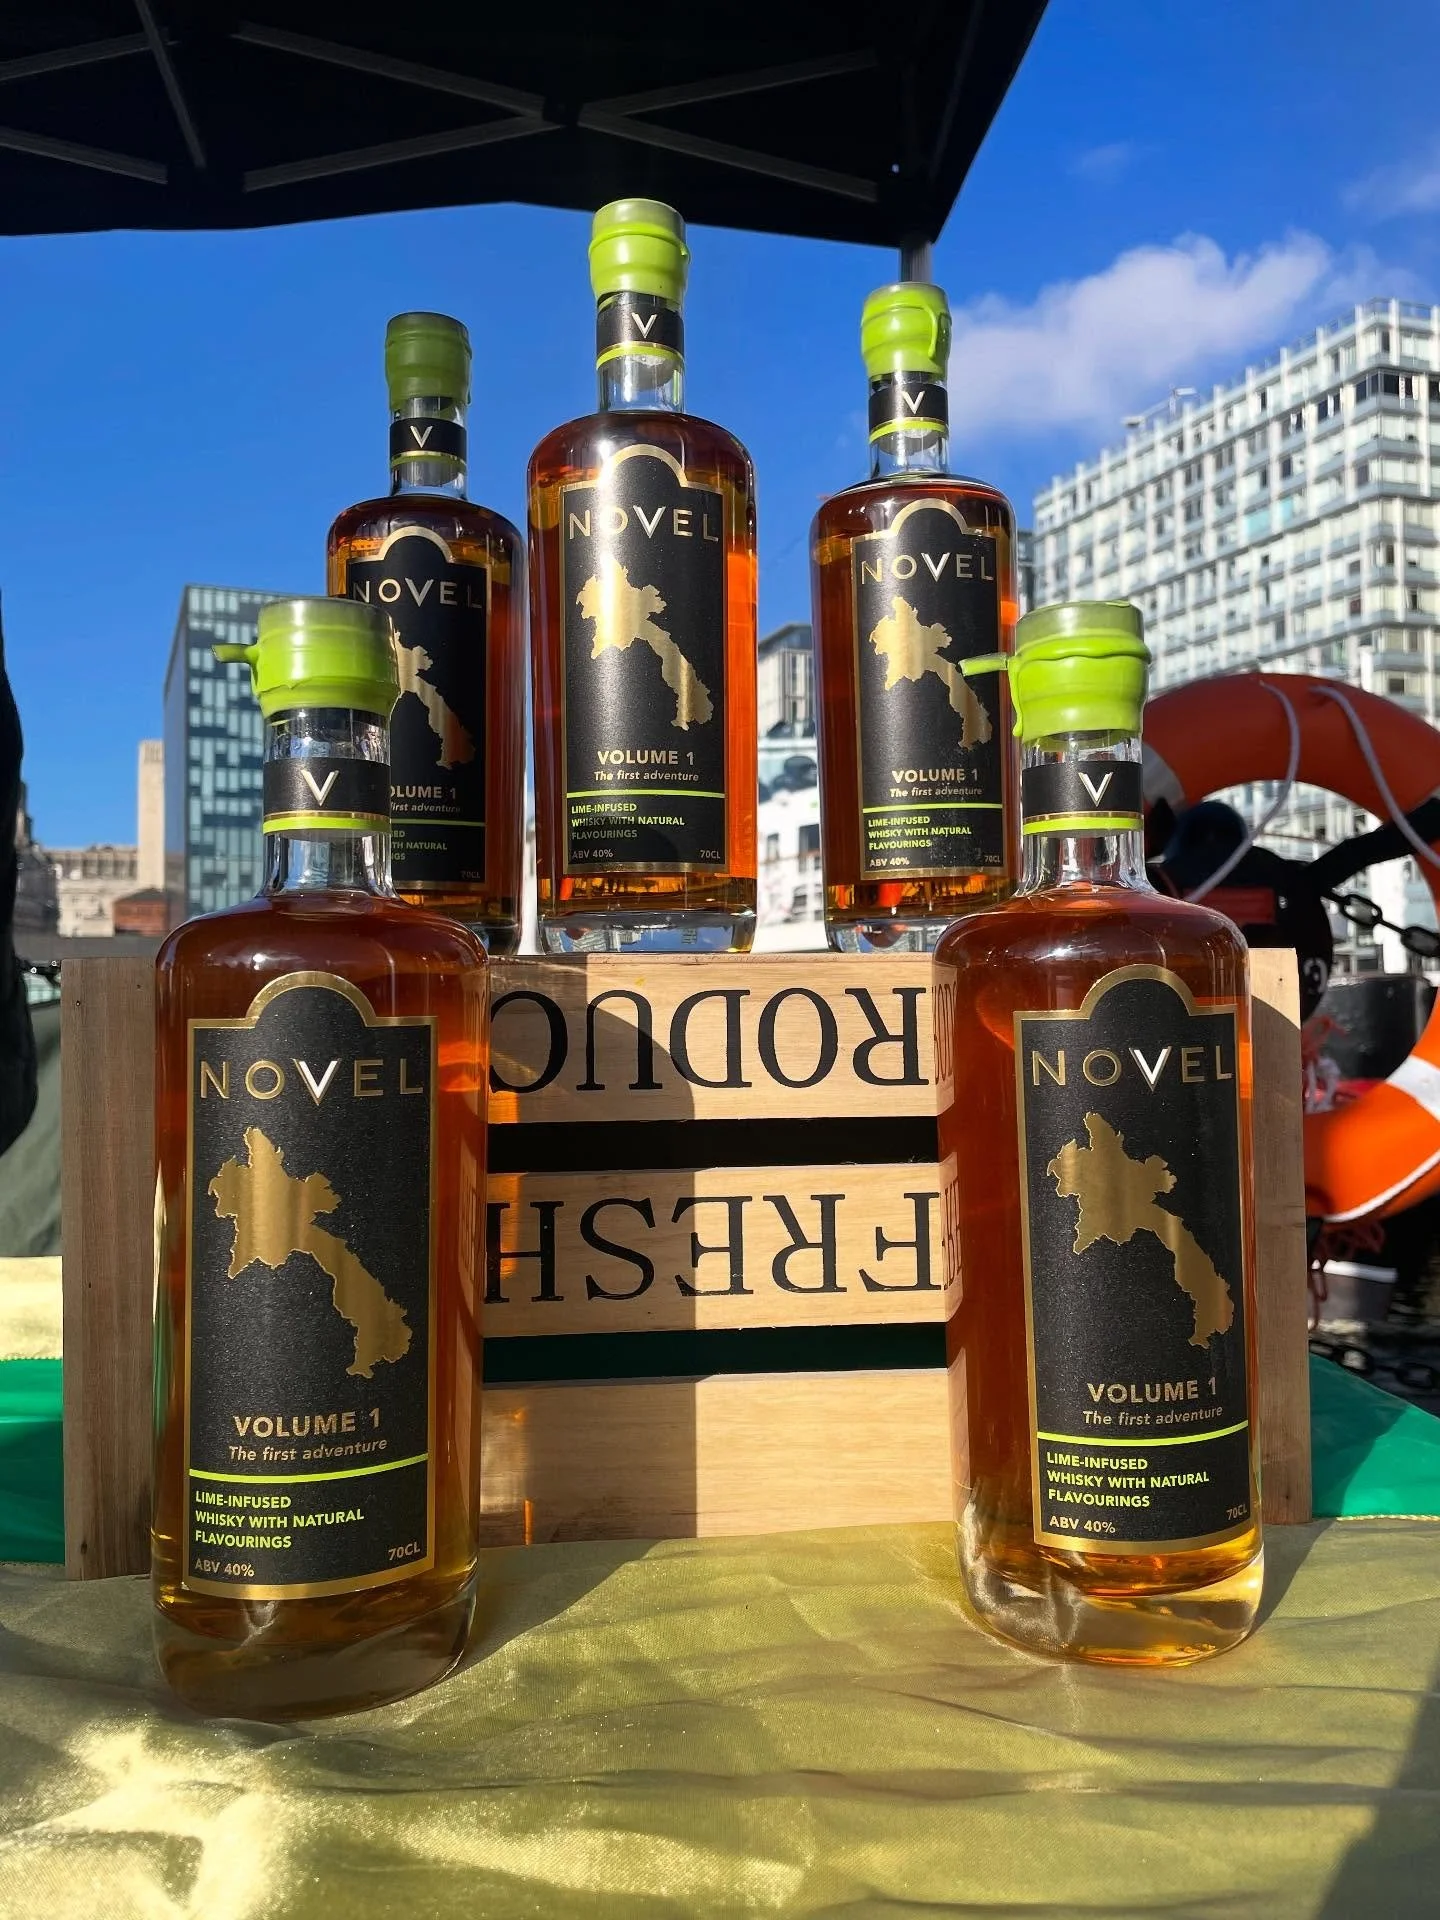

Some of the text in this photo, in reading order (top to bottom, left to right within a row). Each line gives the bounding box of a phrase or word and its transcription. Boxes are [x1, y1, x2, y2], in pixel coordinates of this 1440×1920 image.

[631, 313, 657, 338] V
[900, 390, 925, 414] V
[410, 425, 433, 447] V
[569, 505, 719, 542] NOVEL
[861, 552, 994, 585] NOVEL
[353, 578, 483, 608] NOVEL
[597, 750, 694, 766] VOLUME 1
[594, 770, 699, 782] The first adventure
[891, 768, 978, 783] VOLUME 1
[300, 770, 339, 807] V
[390, 785, 456, 799] LUME 1
[890, 786, 982, 798] The first adventure
[1077, 771, 1114, 807] V
[571, 803, 637, 814] LIME-INFUSED
[572, 816, 686, 827] WHISKY WITH NATURAL
[868, 816, 931, 827] LIME-INFUSED
[572, 829, 638, 840] FLAVOURINGS
[868, 827, 972, 839] WHISKY WITH NATURAL
[406, 841, 448, 850] NATURAL
[572, 849, 614, 859] ABV 40%
[700, 849, 721, 859] 70CL
[869, 839, 932, 850] FLAVOURINGS
[869, 856, 910, 868] ABV 40%
[489, 987, 929, 1094] RODUC
[1032, 1045, 1235, 1094] NOVEL
[200, 1058, 424, 1106] NOVEL
[484, 1192, 942, 1304] FRESH
[1086, 1377, 1216, 1404] VOLUME 1
[233, 1407, 380, 1438] VOLUME 1
[1083, 1406, 1223, 1426] The first adventure
[229, 1438, 388, 1461] The first adventure
[1047, 1452, 1148, 1470] LIME-INFUSED
[1047, 1470, 1210, 1489] WHISKY WITH NATURAL
[195, 1490, 291, 1509] LIME-INFUSED
[1048, 1489, 1150, 1508] FLAVOURINGS
[195, 1508, 365, 1529] WHISKY WITH NATURAL
[1226, 1503, 1248, 1520] 70CL
[1049, 1516, 1116, 1533] ABV 40%
[195, 1530, 292, 1549] FLAVOURINGS
[388, 1541, 421, 1560] 70CL
[194, 1557, 255, 1577] ABV 40%
